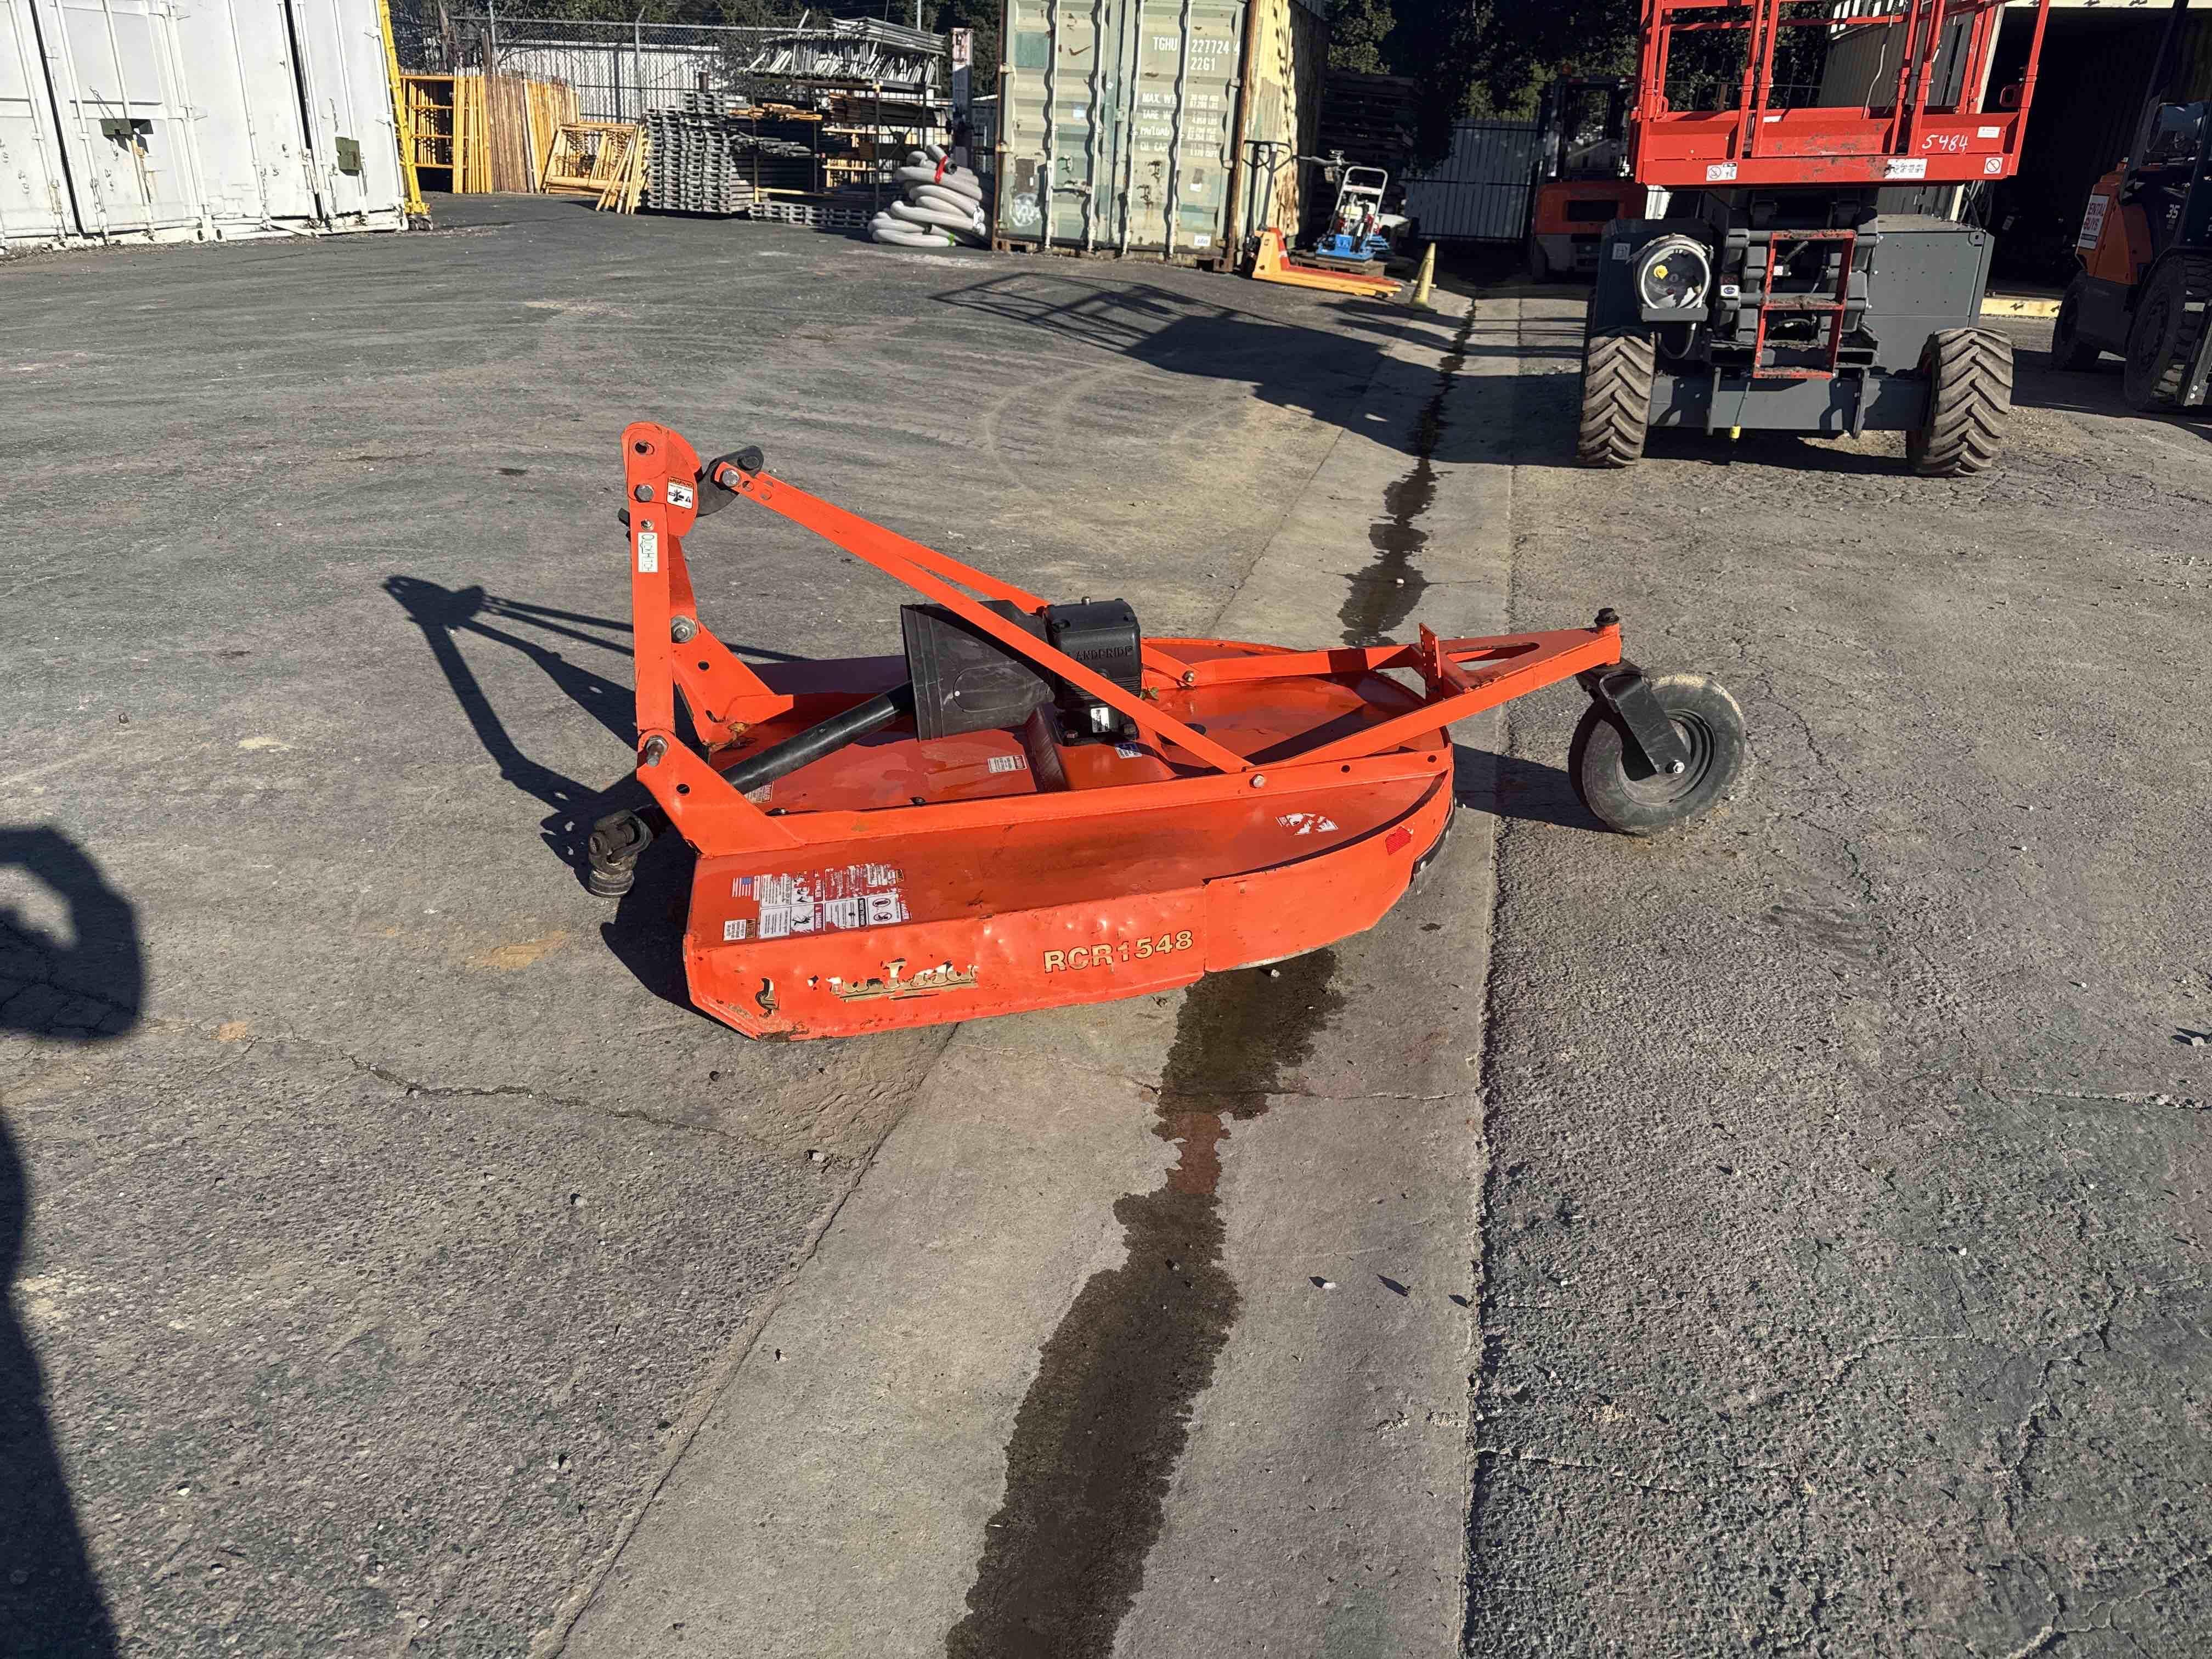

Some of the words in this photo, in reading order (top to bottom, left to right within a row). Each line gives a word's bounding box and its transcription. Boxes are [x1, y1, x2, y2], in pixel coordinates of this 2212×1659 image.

[1153, 37, 1178, 51] TGHU
[1190, 39, 1229, 54] 227724
[1190, 57, 1216, 71] 22G1
[1922, 134, 1968, 153] 5484
[2165, 204, 2181, 219] 35
[1043, 930, 1194, 973] RCR1548
